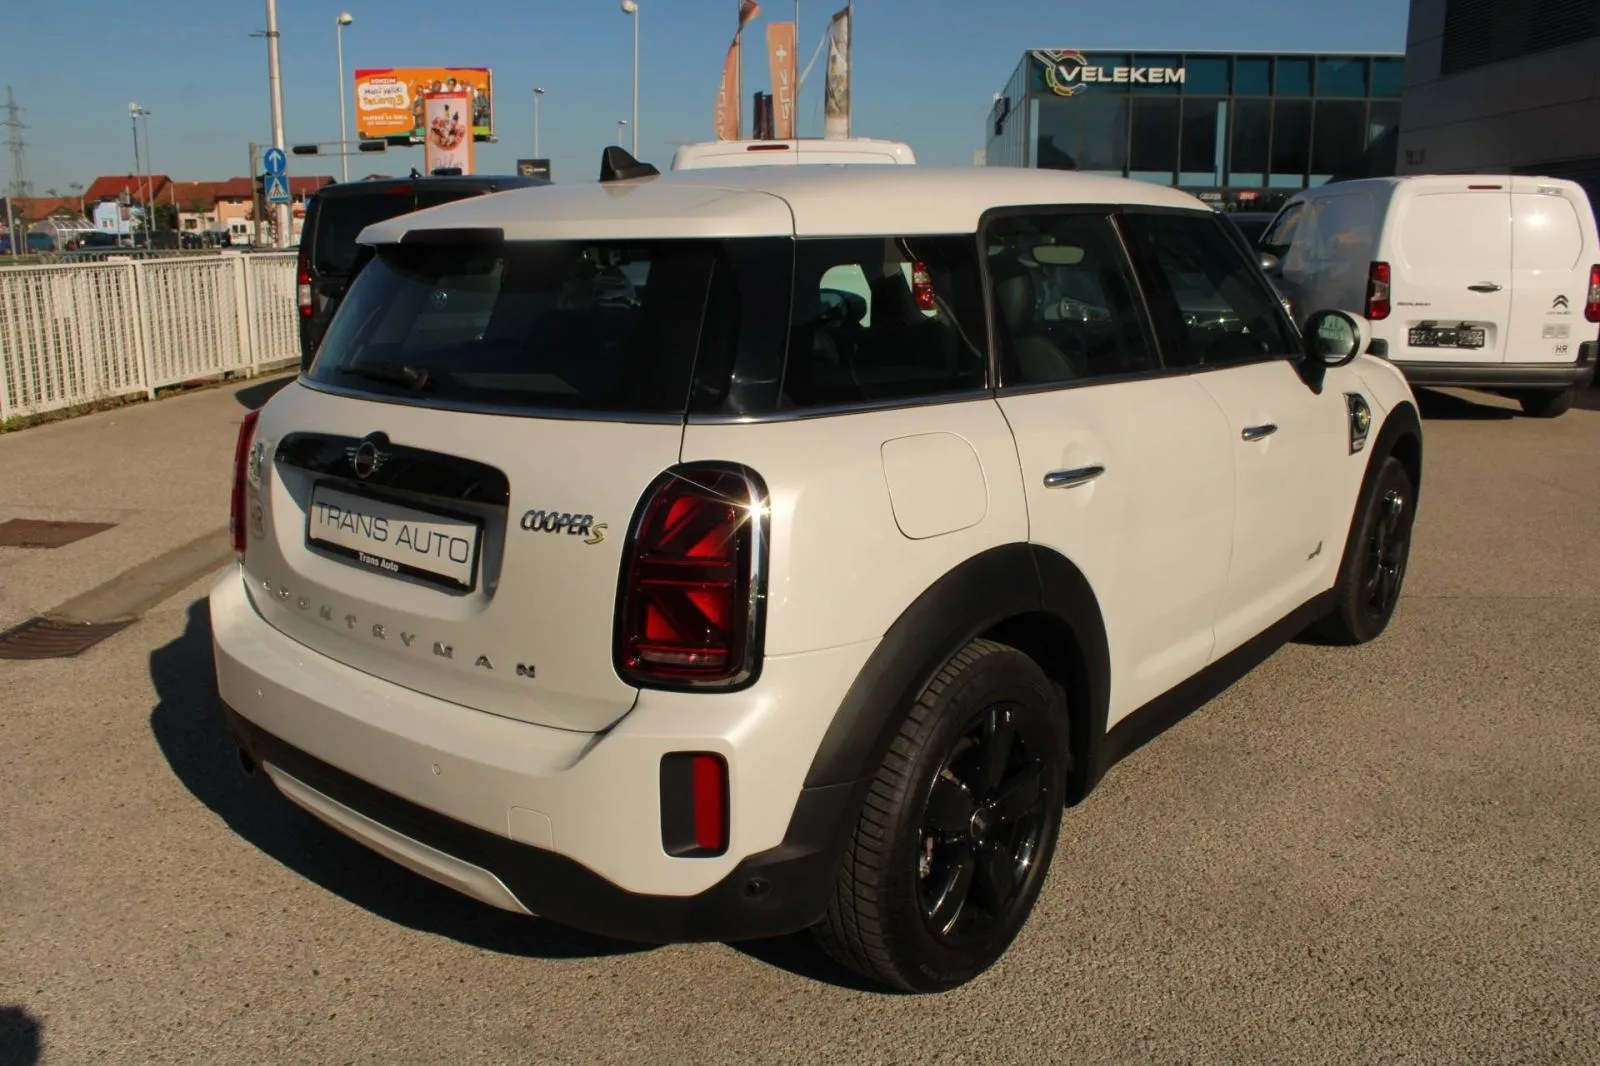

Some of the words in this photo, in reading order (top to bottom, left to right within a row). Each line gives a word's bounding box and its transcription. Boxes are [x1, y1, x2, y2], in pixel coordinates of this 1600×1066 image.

[1058, 66, 1186, 83] VELEKEM
[1554, 344, 1568, 354] HR
[316, 501, 389, 542] TRANS
[395, 524, 470, 564] AUTO
[520, 509, 594, 537] COOPER
[358, 552, 380, 567] Trans
[380, 557, 399, 572] Auto
[262, 578, 537, 679] COUNTRYMAN
